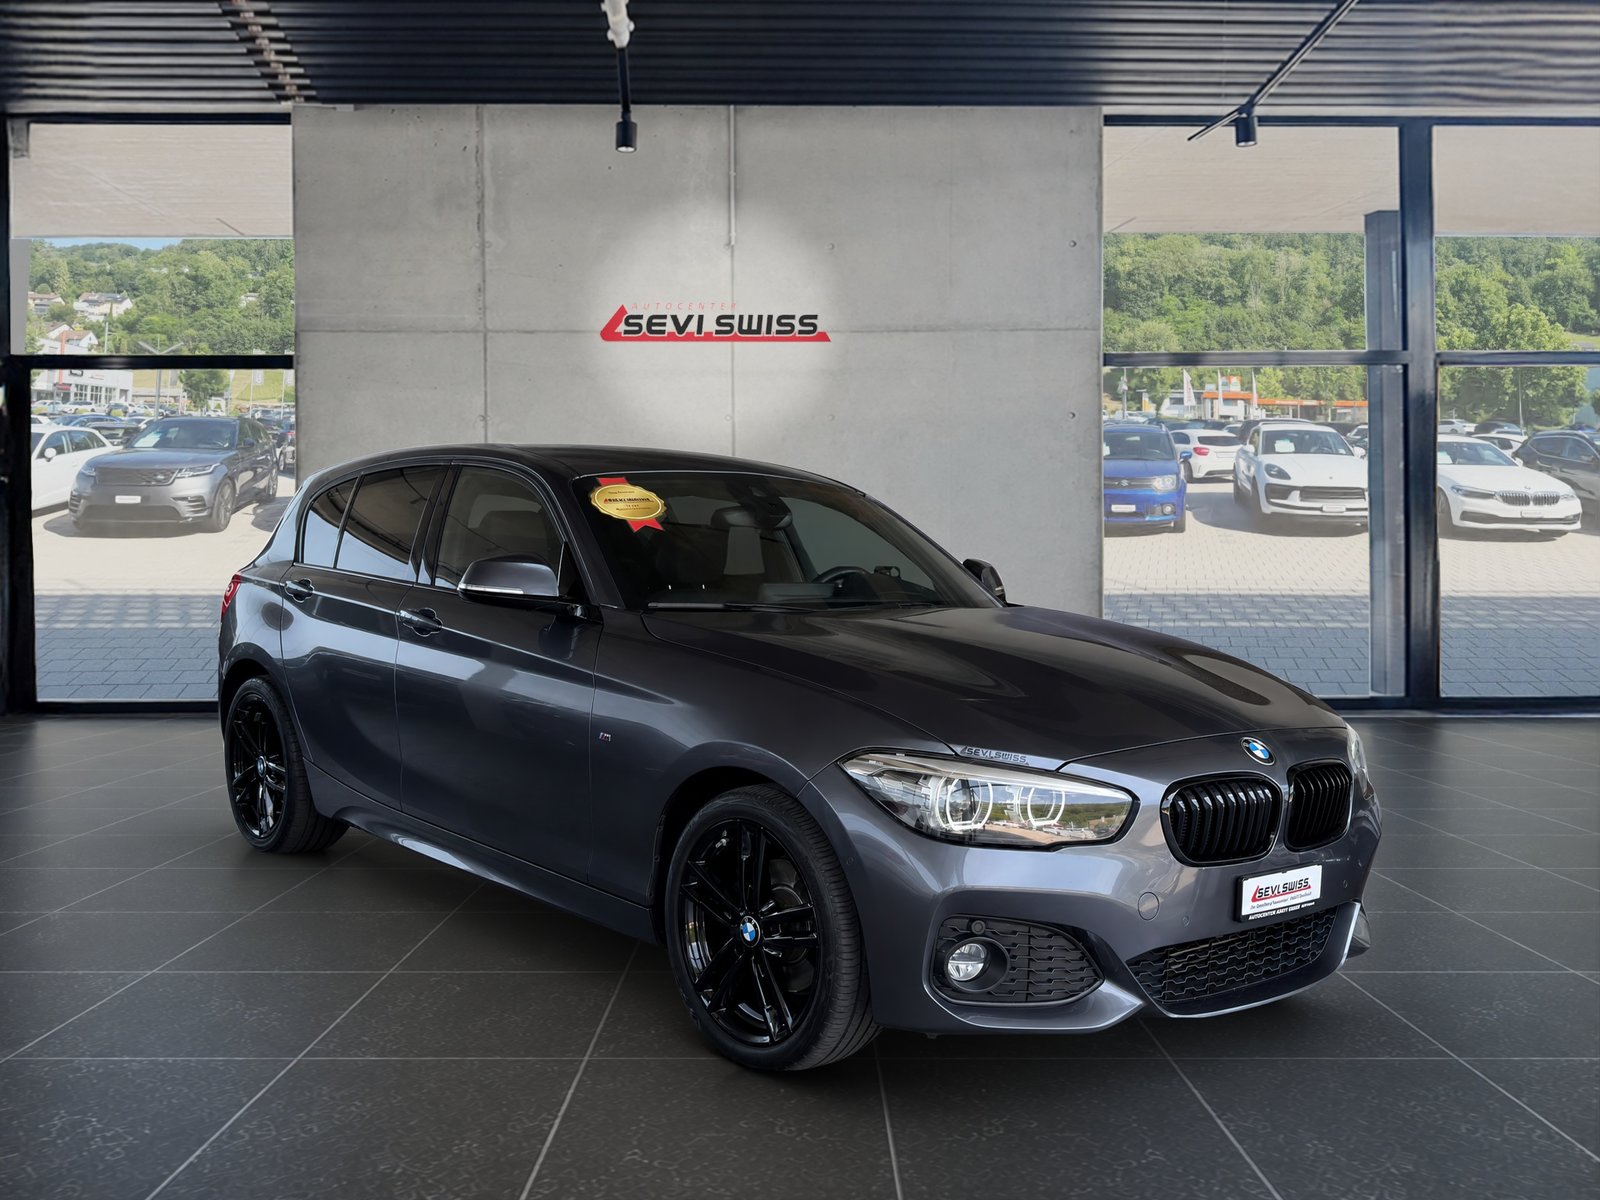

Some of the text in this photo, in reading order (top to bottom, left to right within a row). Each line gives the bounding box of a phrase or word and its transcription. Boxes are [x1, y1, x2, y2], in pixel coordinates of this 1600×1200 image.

[631, 302, 738, 311] AUTOCENTER
[623, 314, 819, 335] SEVI SWISS
